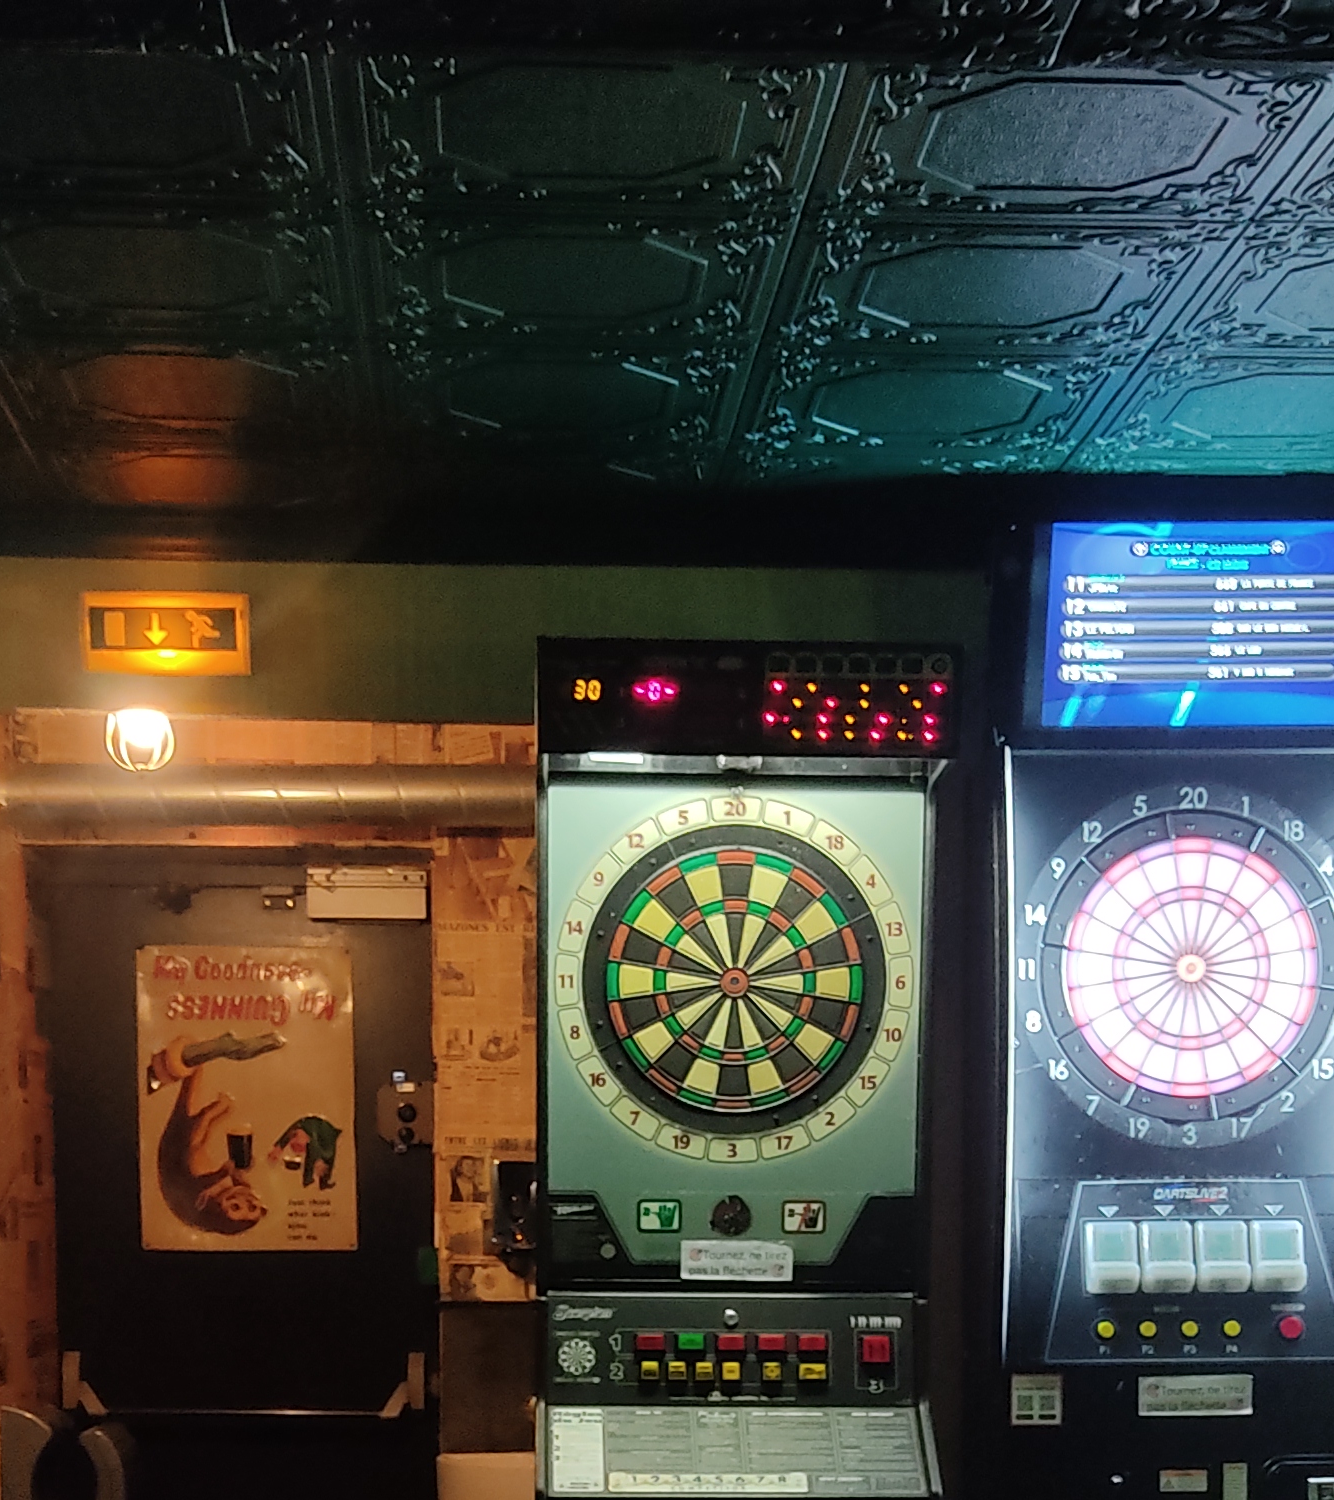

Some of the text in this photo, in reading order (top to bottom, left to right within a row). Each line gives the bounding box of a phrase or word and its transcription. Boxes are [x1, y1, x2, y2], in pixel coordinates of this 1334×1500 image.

[1067, 576, 1085, 593] 11
[1066, 598, 1086, 615] 12
[1064, 620, 1084, 637] 13
[573, 679, 602, 701] 30
[1133, 795, 1148, 817] 5
[1179, 787, 1208, 809] 20
[1241, 796, 1250, 817] 1
[677, 811, 689, 825] 5
[724, 802, 747, 817] 20
[784, 811, 791, 825] 1
[1082, 822, 1102, 843] 12
[1283, 821, 1304, 841] 18
[626, 833, 644, 849] 12
[828, 834, 844, 850] 18
[1051, 858, 1066, 880] 9
[1320, 856, 1334, 876] 4
[593, 871, 604, 886] 9
[866, 874, 877, 889] 4
[1024, 904, 1047, 926] 14
[566, 920, 584, 936] 14
[886, 922, 903, 937] 13
[1018, 959, 1035, 981] 11
[559, 974, 575, 989] 11
[895, 976, 906, 990] 6
[1025, 1010, 1042, 1033] 8
[570, 1025, 581, 1040] 8
[883, 1028, 902, 1043] 10
[1048, 1059, 1070, 1080] 16
[1312, 1059, 1334, 1080] 15
[590, 1072, 607, 1087] 16
[860, 1075, 877, 1090] 15
[1086, 1097, 1100, 1116] 7
[1279, 1092, 1295, 1112] 2
[629, 1111, 640, 1125] 7
[824, 1112, 836, 1127] 2
[1129, 1118, 1149, 1138] 19
[1182, 1125, 1197, 1145] 3
[1231, 1117, 1255, 1138] 17
[672, 1135, 691, 1150] 19
[727, 1144, 737, 1158] 3
[776, 1136, 793, 1150] 17
[1153, 1187, 1229, 1201] DARTSLIVE2
[609, 1334, 622, 1354] 1
[609, 1363, 624, 1380] 2
